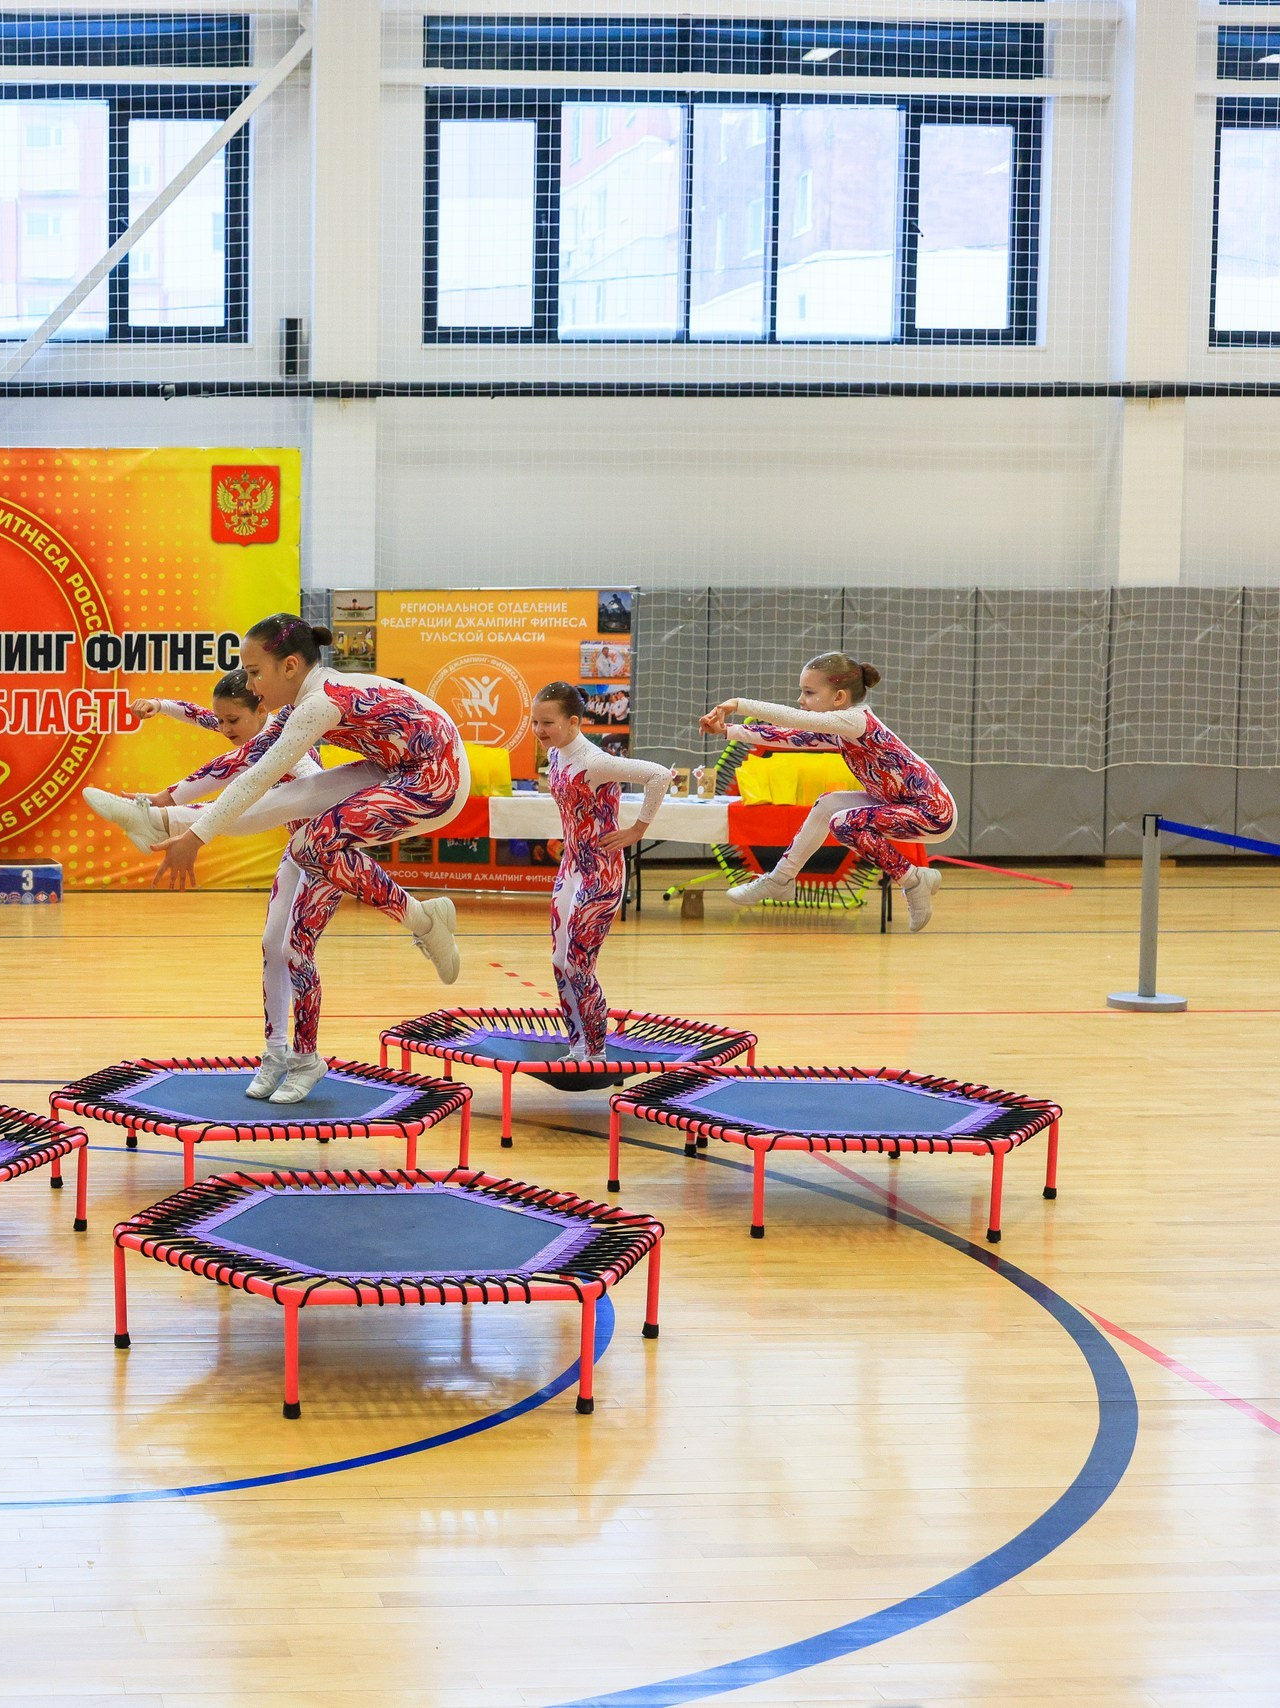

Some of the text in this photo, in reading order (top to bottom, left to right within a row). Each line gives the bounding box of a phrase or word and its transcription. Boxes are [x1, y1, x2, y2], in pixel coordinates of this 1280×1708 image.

[65, 572, 104, 636] РОСС
[400, 602, 568, 614] РЕГИОНАЛЬНОЕ ОТДЕЛЕНИЕ
[380, 617, 588, 629] ФЕДЕРАЦИИ ДЖАМПИНГ ФИТНЕСА
[420, 630, 545, 642] ТУЛЬСКОЙ ОБЛАСТИ
[85, 632, 245, 675] ФИТНЕС
[21, 869, 34, 891] 3
[474, 873, 523, 882] ДЖАМПИНГ
[525, 875, 558, 883] ФИТНЕС
